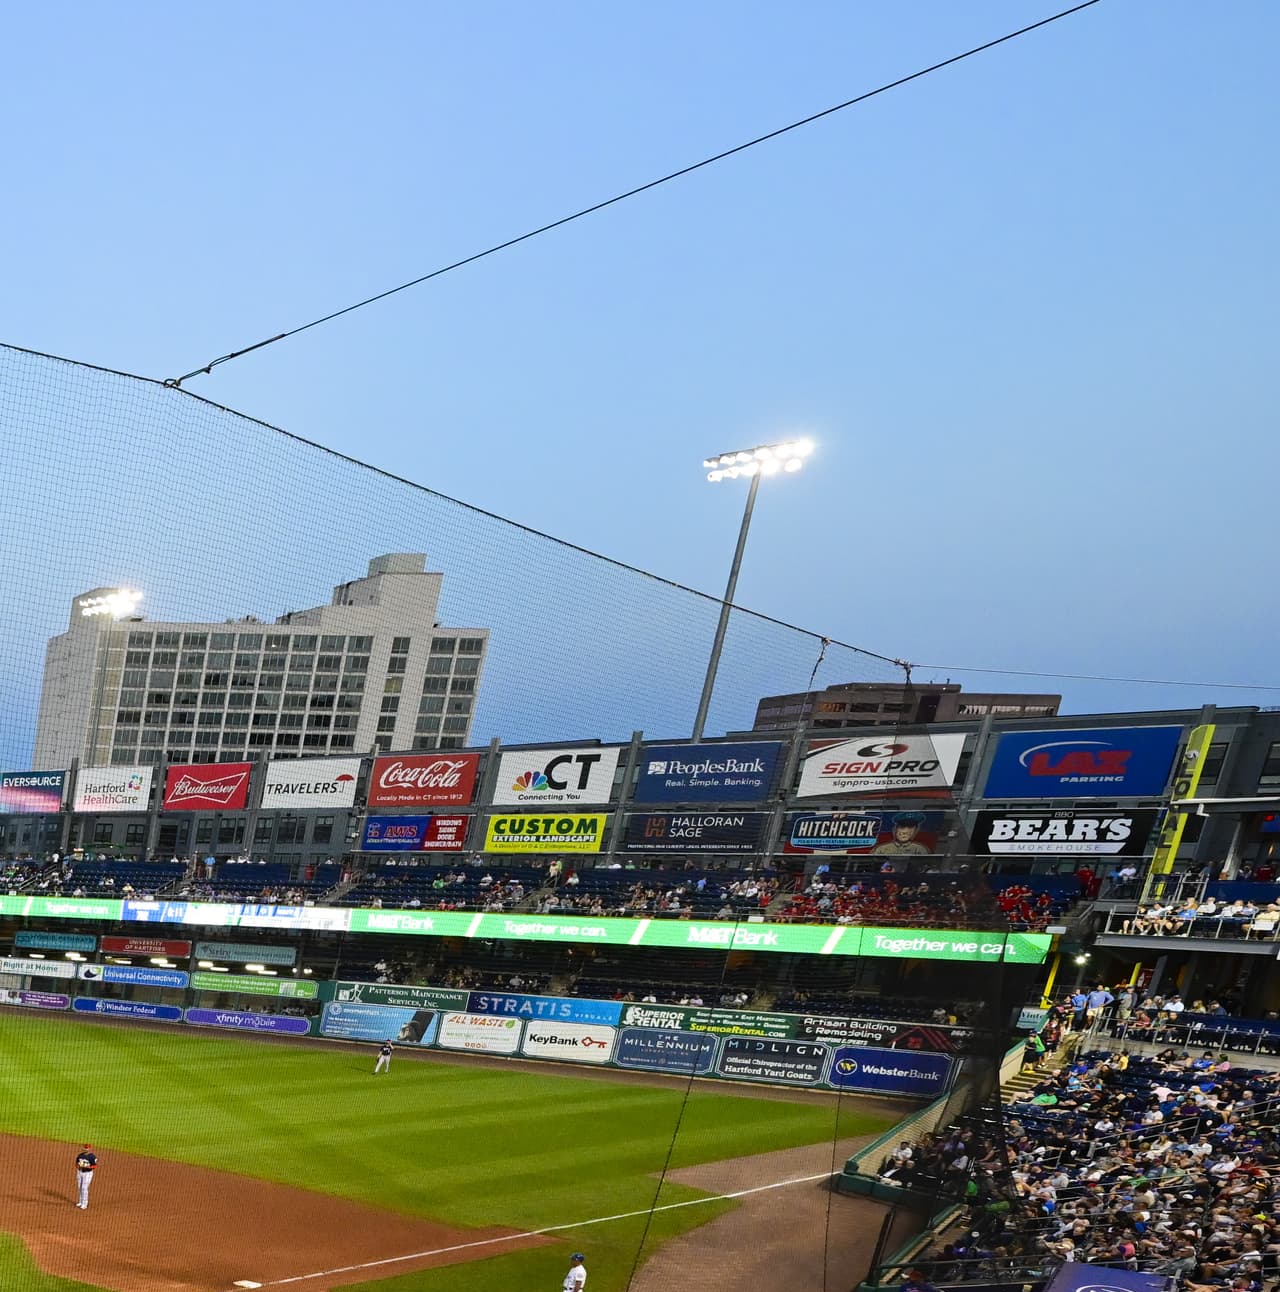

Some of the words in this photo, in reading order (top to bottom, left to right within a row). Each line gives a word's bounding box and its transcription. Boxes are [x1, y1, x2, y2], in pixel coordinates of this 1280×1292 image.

[668, 758, 766, 778] PeoplesBank
[822, 762, 883, 774] SIGN
[883, 760, 940, 773] PRO
[1029, 751, 1132, 776] LAZ
[544, 754, 601, 790] CT
[3, 776, 62, 787] EVERSOURCE
[84, 782, 127, 793] Hartford
[175, 781, 238, 796] Budweiser
[266, 782, 338, 795] TRAVELERS
[665, 779, 686, 787] Real.
[689, 779, 721, 787] Simple.
[724, 779, 763, 787] Banking.
[832, 778, 918, 787] signpro-usa.com
[83, 793, 138, 805] HealthCare
[494, 818, 598, 835] CUSTOM
[671, 817, 744, 827] HALLORAN
[798, 821, 876, 837] HITCHCOCK
[384, 826, 418, 838] AWS
[669, 828, 703, 838] SAGE
[988, 819, 1132, 841] BEAR'S
[503, 919, 557, 936] Together
[558, 925, 575, 935] we
[874, 935, 949, 952] Together
[951, 941, 977, 953] we
[980, 939, 1017, 955] can.
[3, 961, 25, 971] Right
[37, 964, 59, 972] Home
[104, 968, 137, 980] Universal
[137, 971, 182, 985] Connectivity
[369, 987, 409, 996] PATTERSON
[410, 989, 463, 1001] MAINTENANCE
[106, 1002, 131, 1013] Windsor
[132, 1005, 157, 1015] Federal
[477, 996, 572, 1017] STRATIS
[215, 1014, 244, 1026] xfinity
[244, 1016, 277, 1028] mobile
[448, 1015, 467, 1024] ALL
[470, 1016, 505, 1027] WASTE
[803, 1018, 847, 1029] Artisan
[850, 1021, 897, 1034] Building
[529, 1033, 578, 1046] KeyBank
[624, 1038, 710, 1052] MILLENNIUM
[726, 1056, 751, 1065] Official
[803, 1063, 818, 1071] the
[724, 1065, 762, 1075] Hartford
[764, 1068, 785, 1078] Yard
[786, 1071, 814, 1080] Goats.
[862, 1064, 940, 1081] WebsterBank
